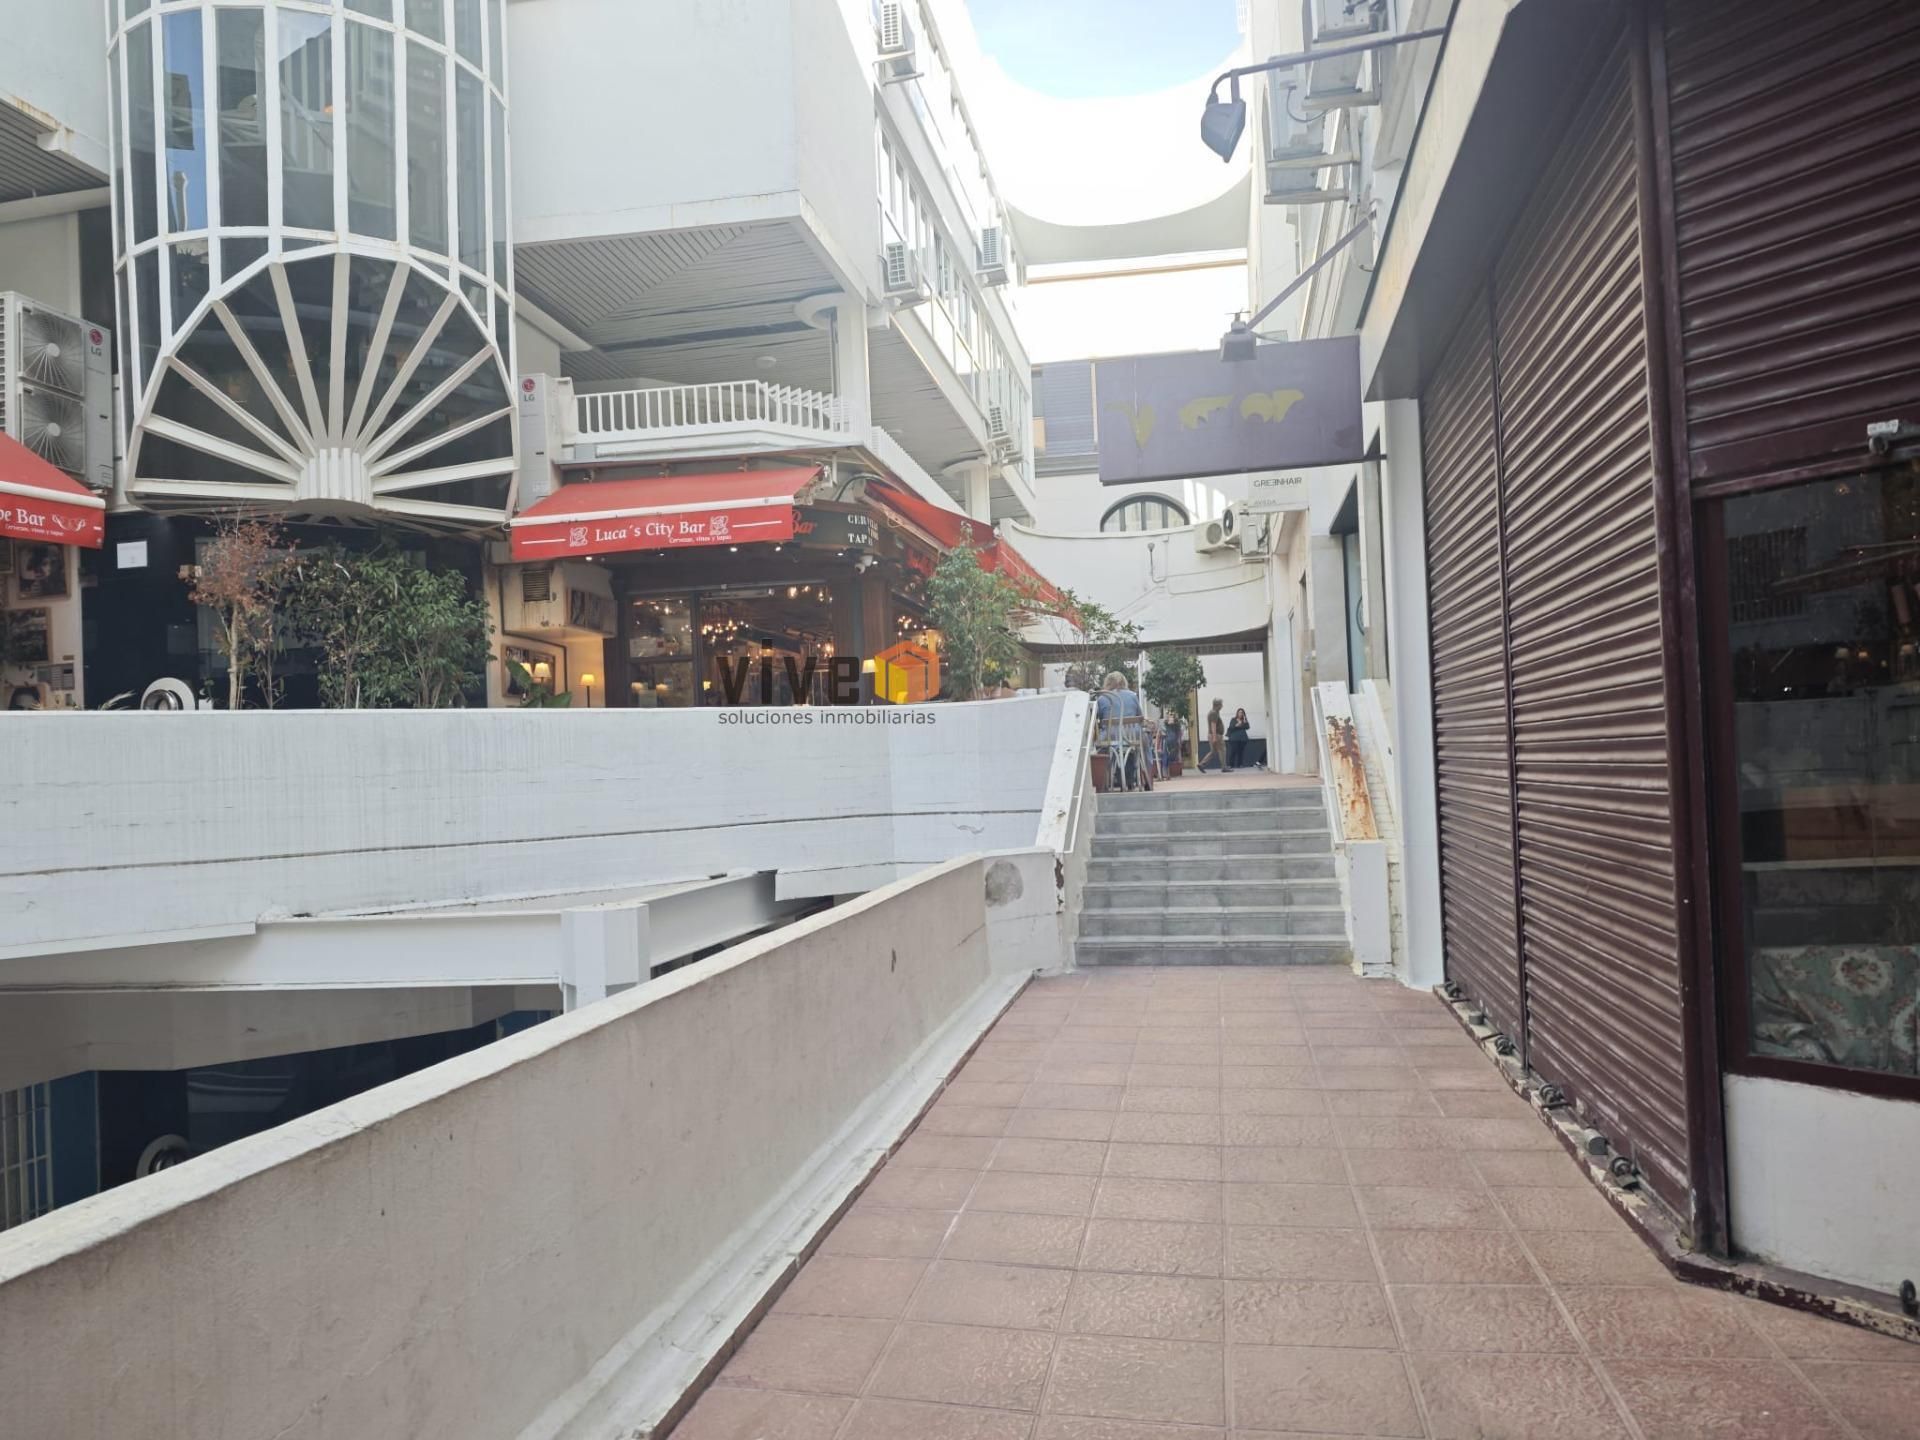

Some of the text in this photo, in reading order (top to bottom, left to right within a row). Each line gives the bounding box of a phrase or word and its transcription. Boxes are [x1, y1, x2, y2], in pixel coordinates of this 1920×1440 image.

[90, 346, 102, 357] LG
[523, 394, 535, 402] LG
[16, 508, 45, 526] Bar
[646, 522, 674, 538] City
[680, 521, 705, 535] Bar
